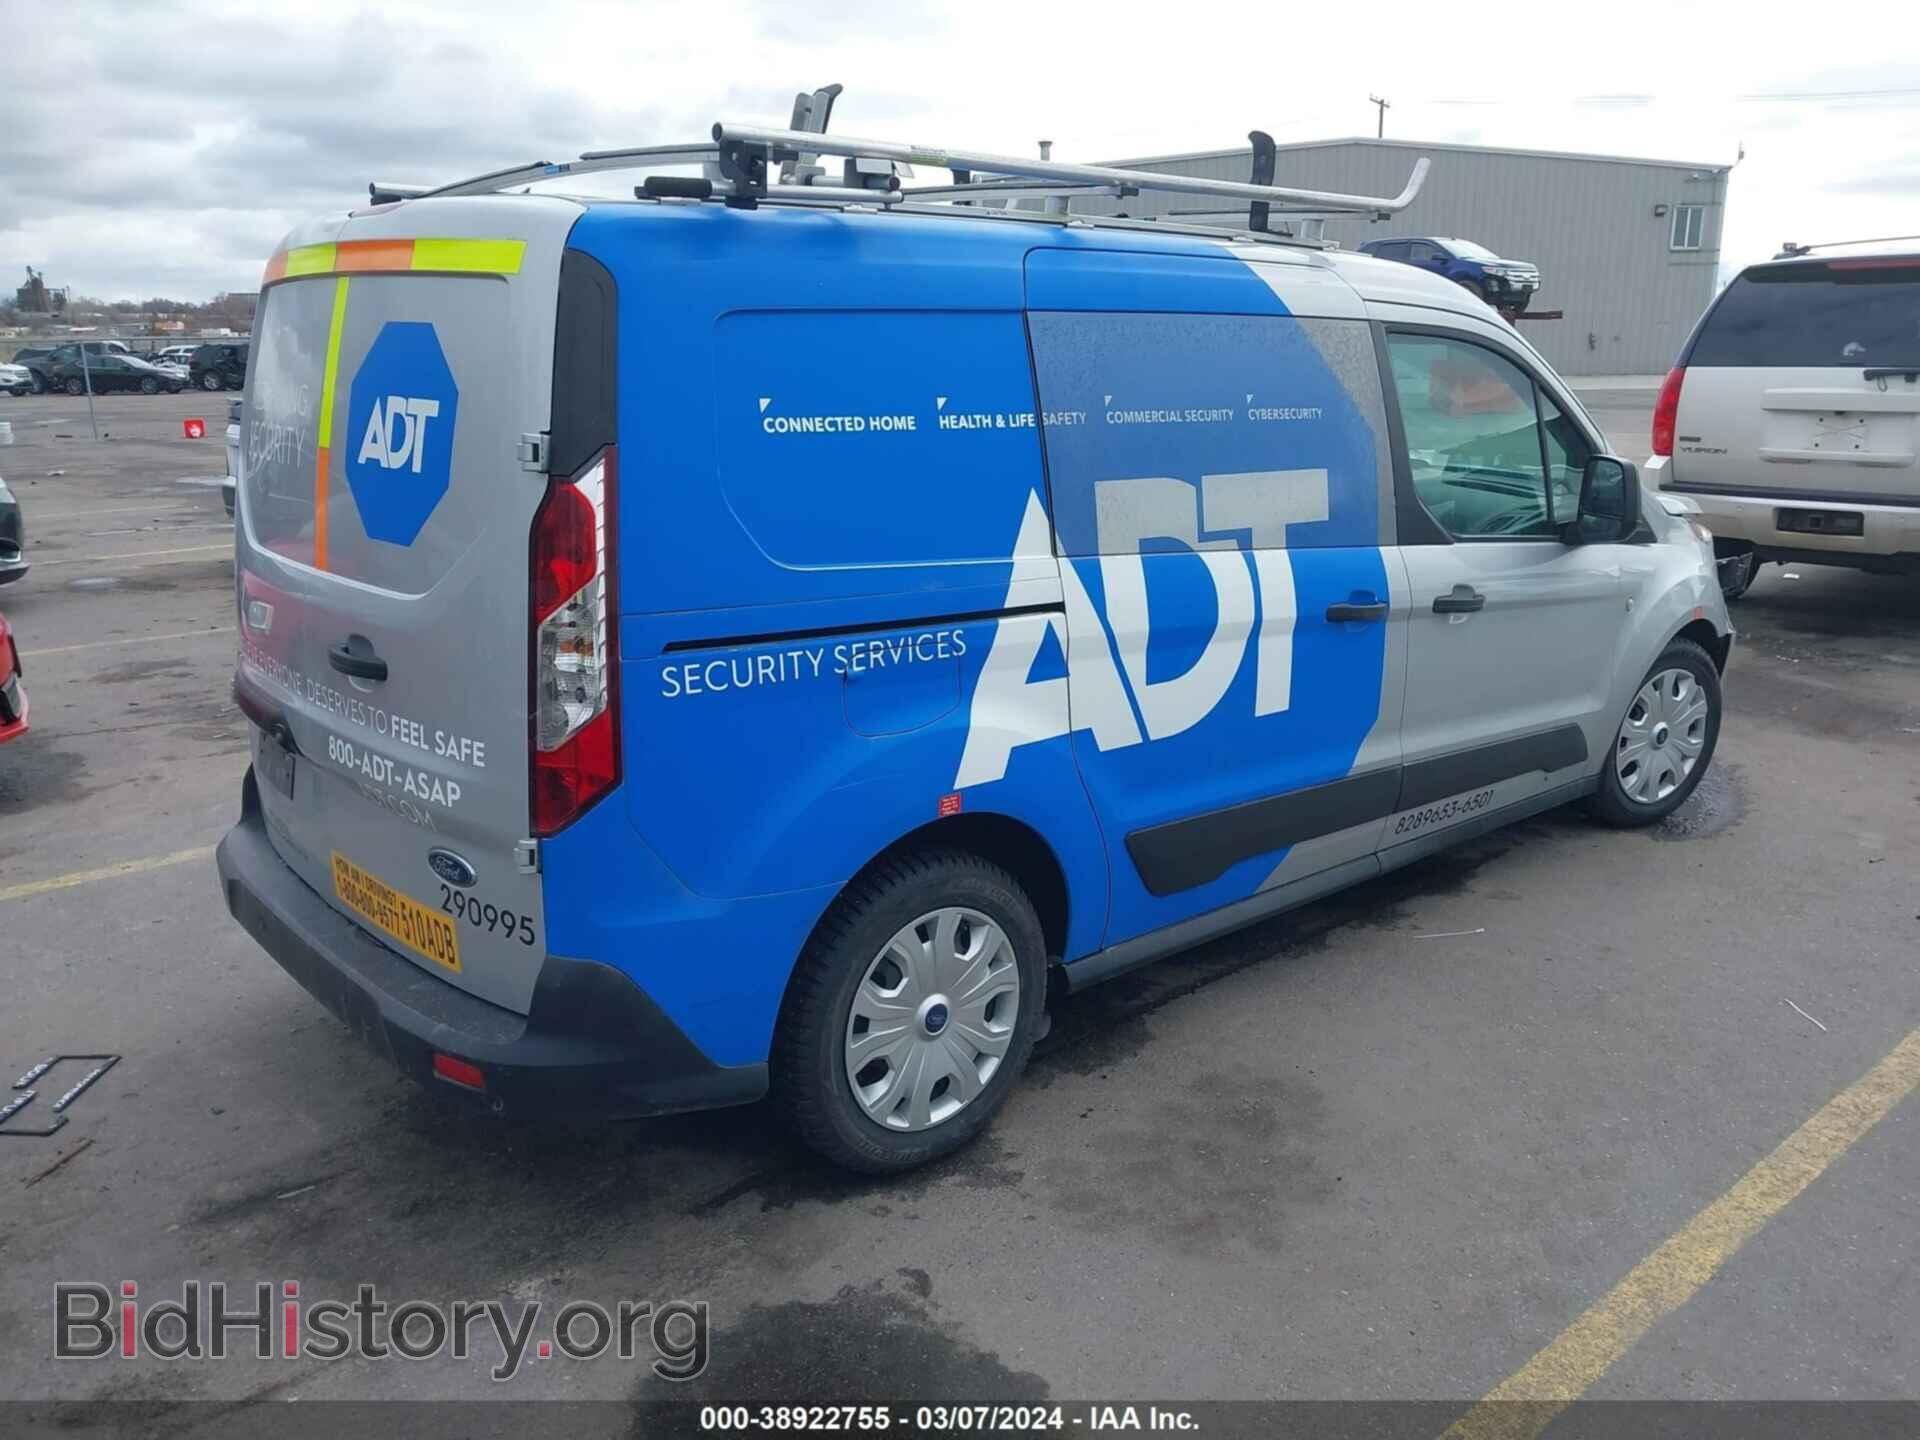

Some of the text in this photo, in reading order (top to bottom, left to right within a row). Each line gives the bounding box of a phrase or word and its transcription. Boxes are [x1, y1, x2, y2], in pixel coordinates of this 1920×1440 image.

[357, 395, 440, 473] ADT
[763, 415, 916, 433] CONNECTED HOME
[939, 411, 1086, 429] HEALTH & LIFE SAFETY
[1106, 409, 1234, 424] COMMERCIAL SECURITY
[1248, 407, 1322, 421] CYBERSECURITY
[953, 468, 1330, 790] ADT
[661, 629, 967, 698] SECURITY SERVICES
[306, 677, 366, 727] DESERVES
[367, 701, 387, 735] TO
[391, 714, 429, 750] FEEL
[434, 730, 486, 767] SAFE
[328, 735, 461, 808] 800-ADT-ASAP
[1394, 789, 1494, 835] 8289653-6501
[440, 883, 536, 947] 290995
